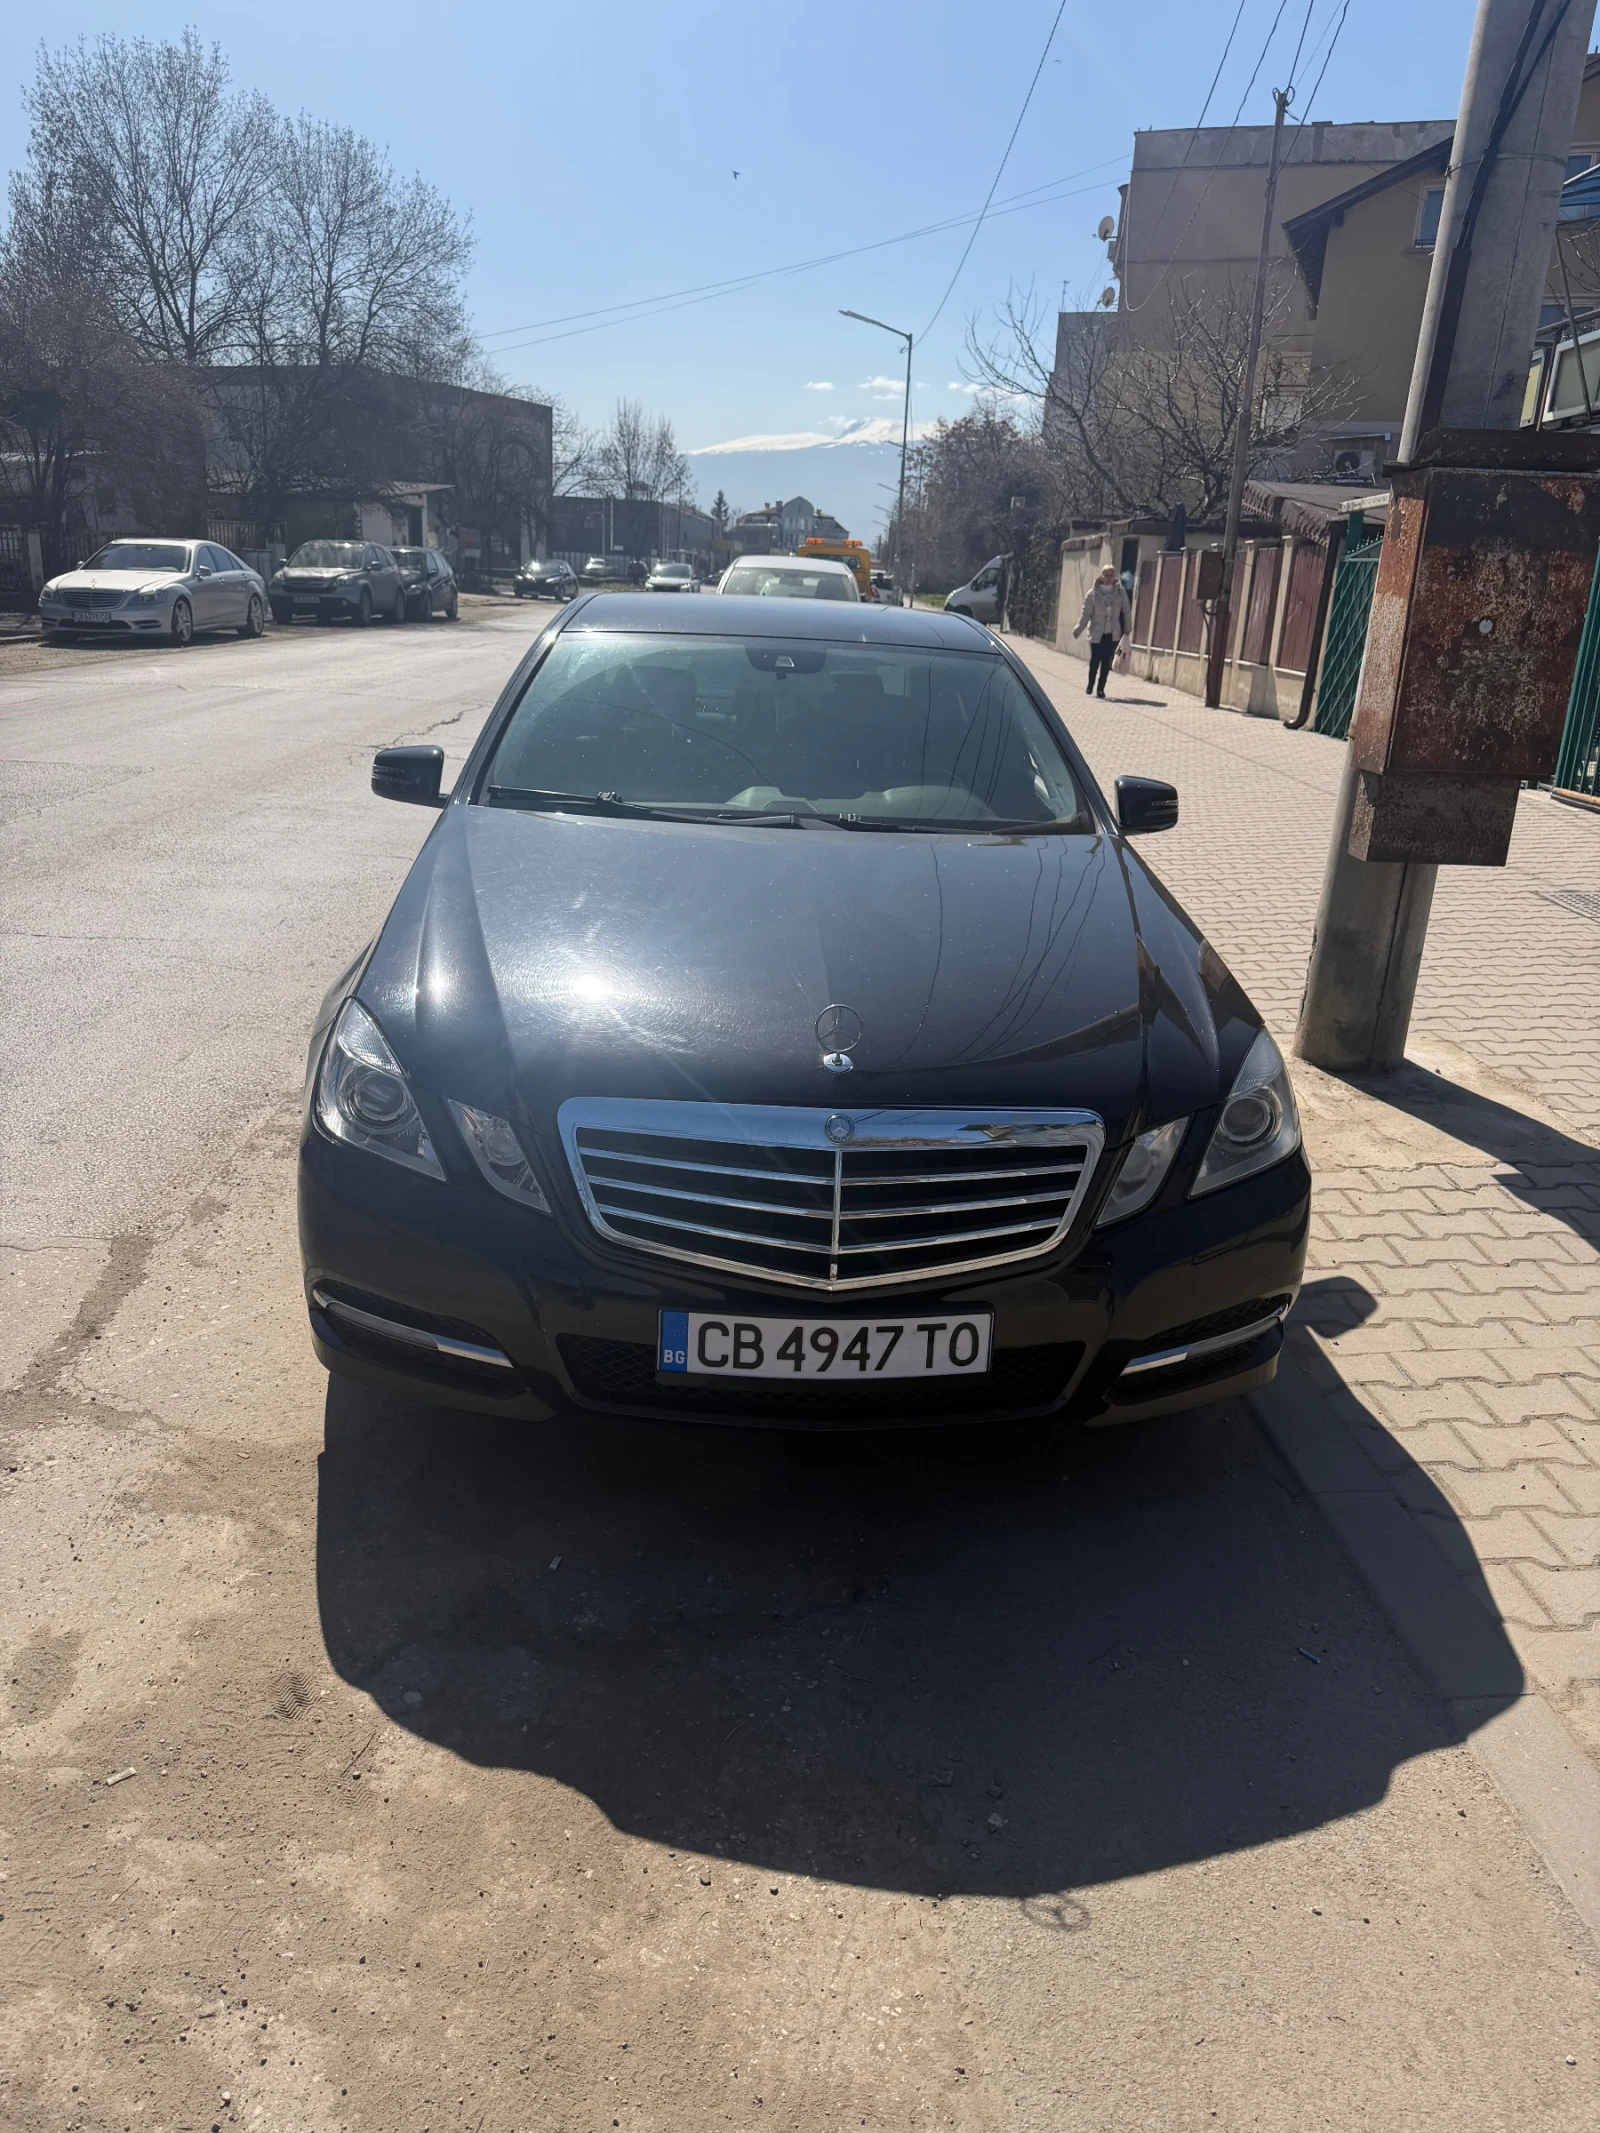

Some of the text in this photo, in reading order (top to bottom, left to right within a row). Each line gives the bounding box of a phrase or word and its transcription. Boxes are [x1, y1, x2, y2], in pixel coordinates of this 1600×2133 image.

[663, 1349, 685, 1364] BG
[697, 1321, 979, 1372] CB 4947 TO
